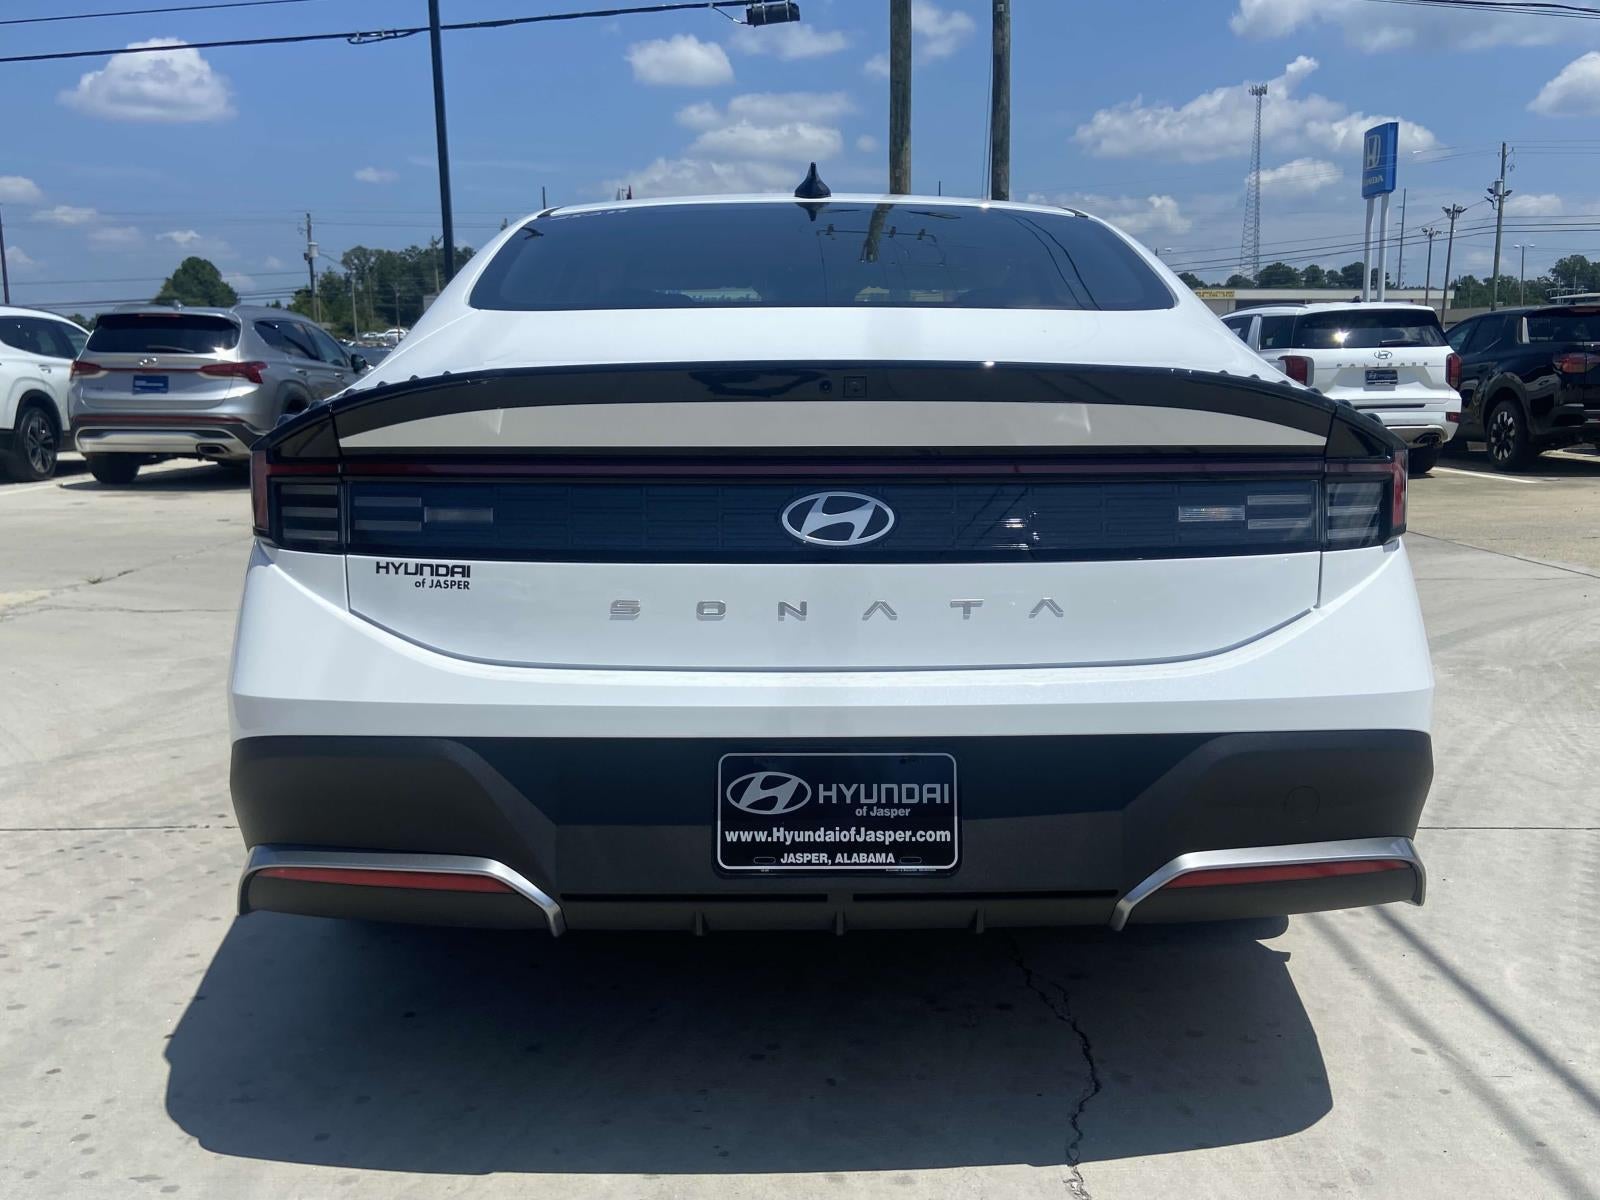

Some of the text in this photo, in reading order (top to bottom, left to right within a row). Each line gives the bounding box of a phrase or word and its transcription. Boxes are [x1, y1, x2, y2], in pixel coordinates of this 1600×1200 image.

[376, 561, 471, 578] HYUNDAI
[414, 578, 470, 590] of JASPER
[609, 597, 1065, 621] SONATA
[818, 783, 950, 804] HYUNDAI
[855, 806, 911, 818] of Jasper
[725, 826, 951, 845] www.HyundaiofJasper.com
[780, 852, 895, 866] JASPER, ALABAMA
